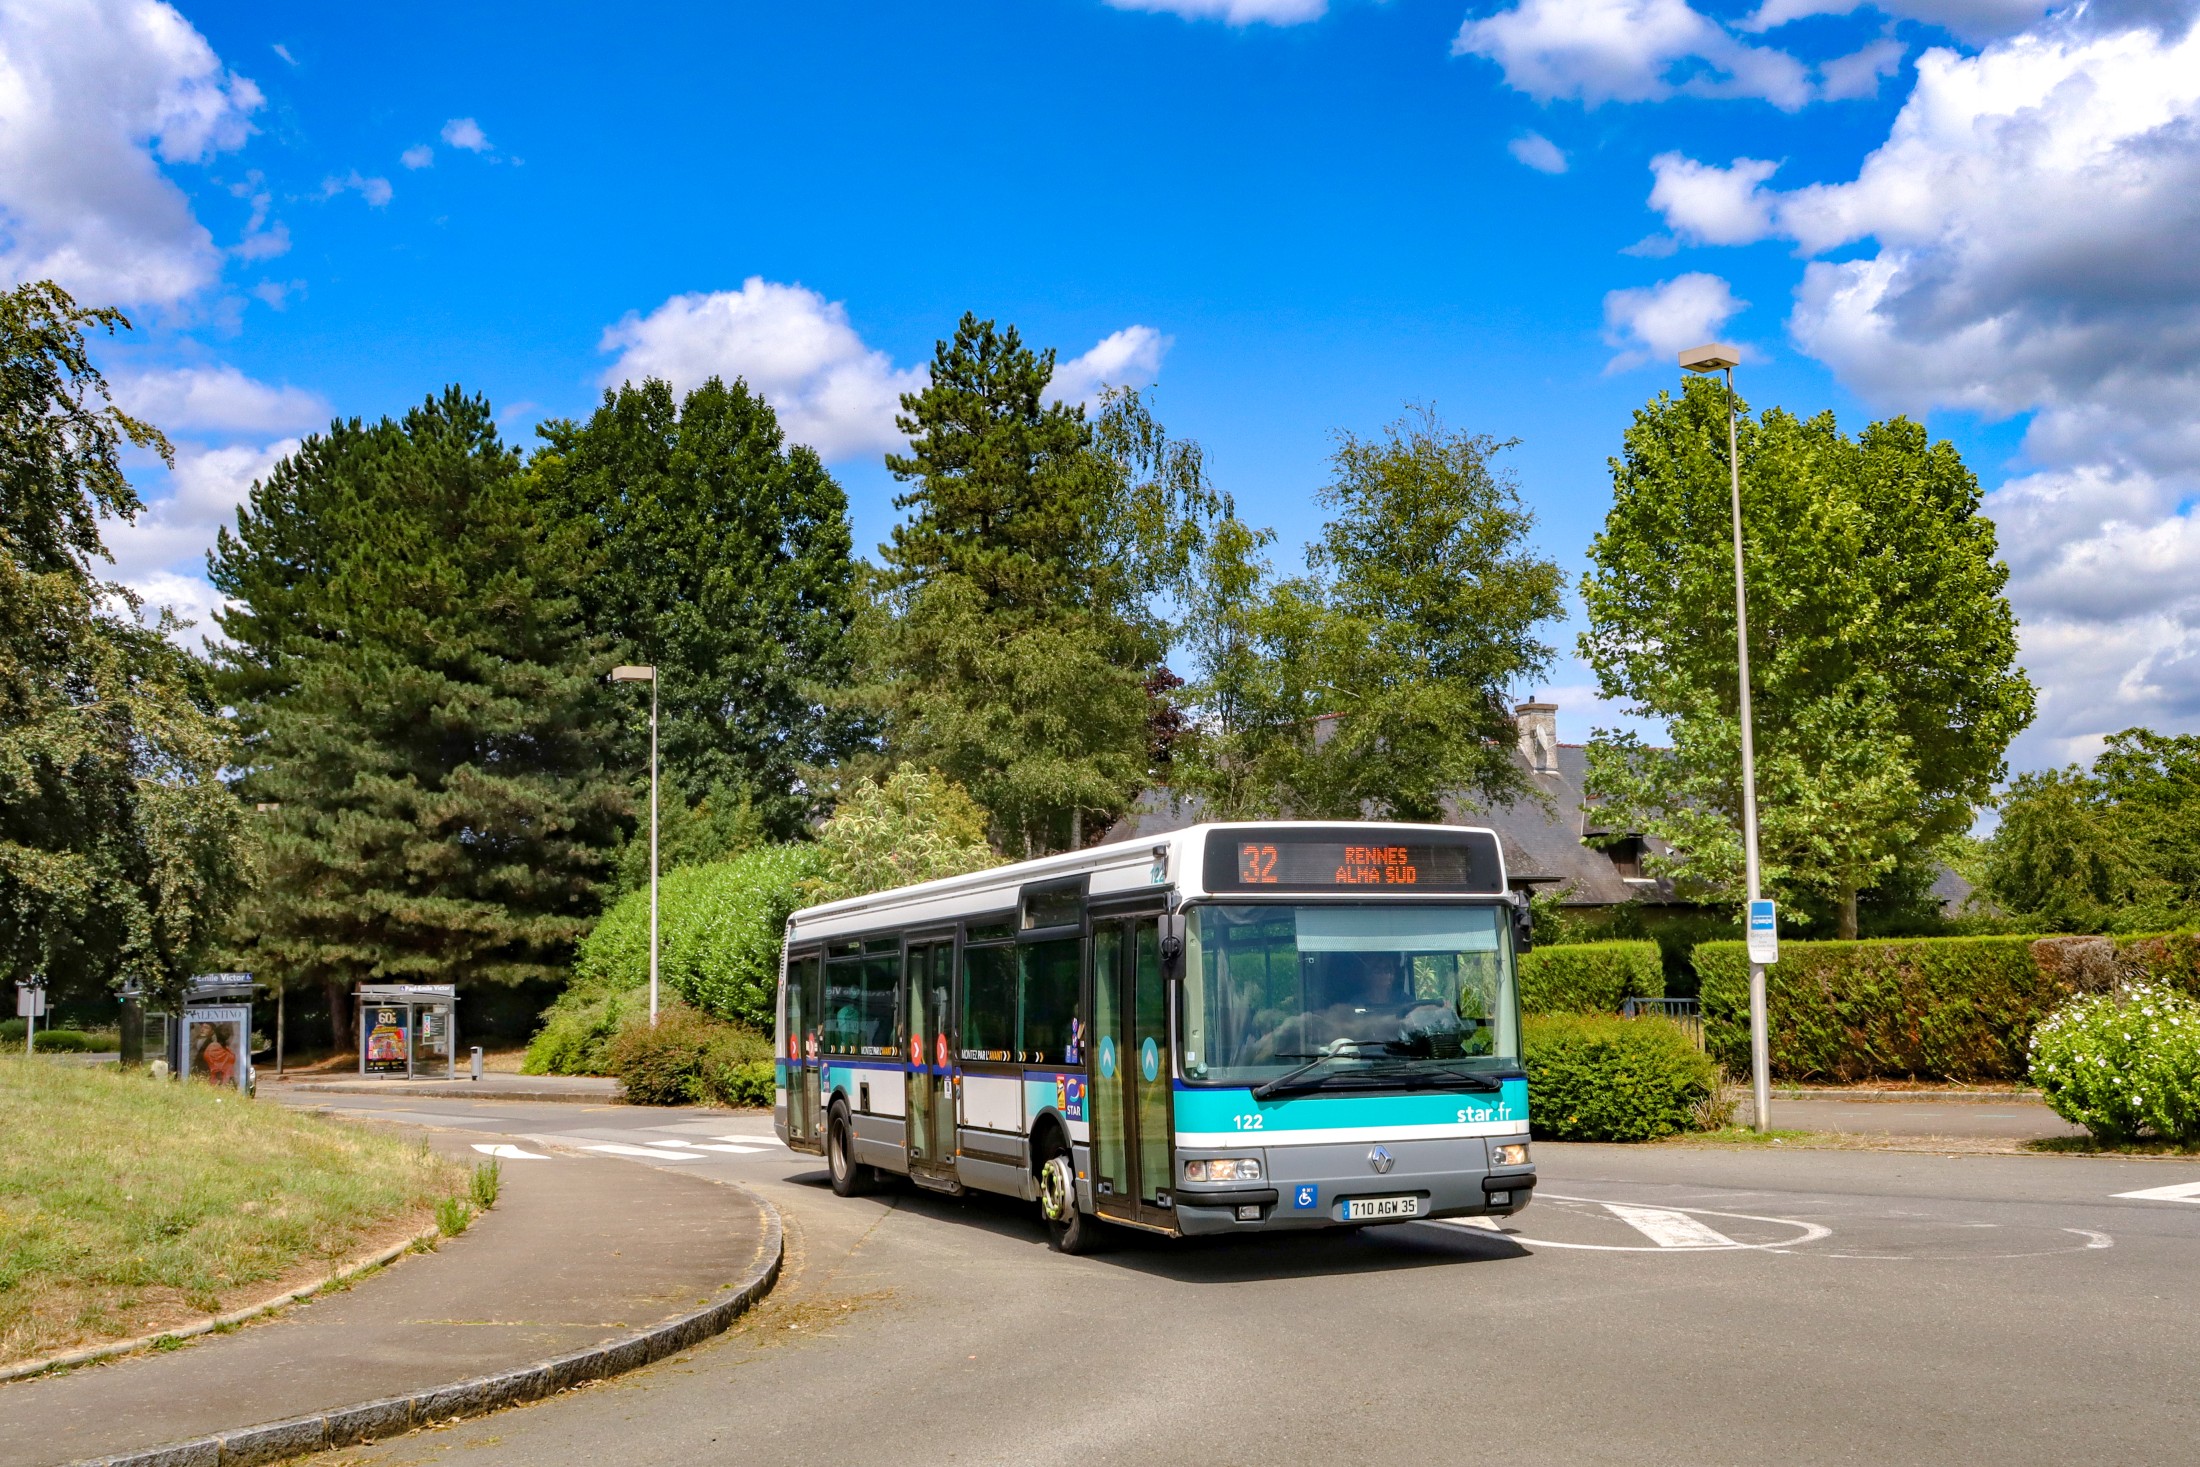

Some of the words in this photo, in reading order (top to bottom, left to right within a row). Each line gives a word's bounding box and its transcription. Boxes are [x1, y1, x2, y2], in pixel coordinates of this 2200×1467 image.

[1242, 845, 1278, 884] 32
[1345, 847, 1408, 865] RENNES
[1335, 866, 1380, 884] ALMA
[1386, 866, 1416, 884] SUD
[220, 973, 245, 981] Victor
[961, 1049, 977, 1060] MONTEZ
[986, 1050, 1003, 1061] L'AVANT
[1067, 1105, 1081, 1116] STAR
[1456, 1101, 1512, 1123] star.fr
[1233, 1114, 1264, 1130] 122
[1352, 1202, 1374, 1216] 710
[1378, 1201, 1398, 1214] AGW
[1401, 1199, 1415, 1213] 35
